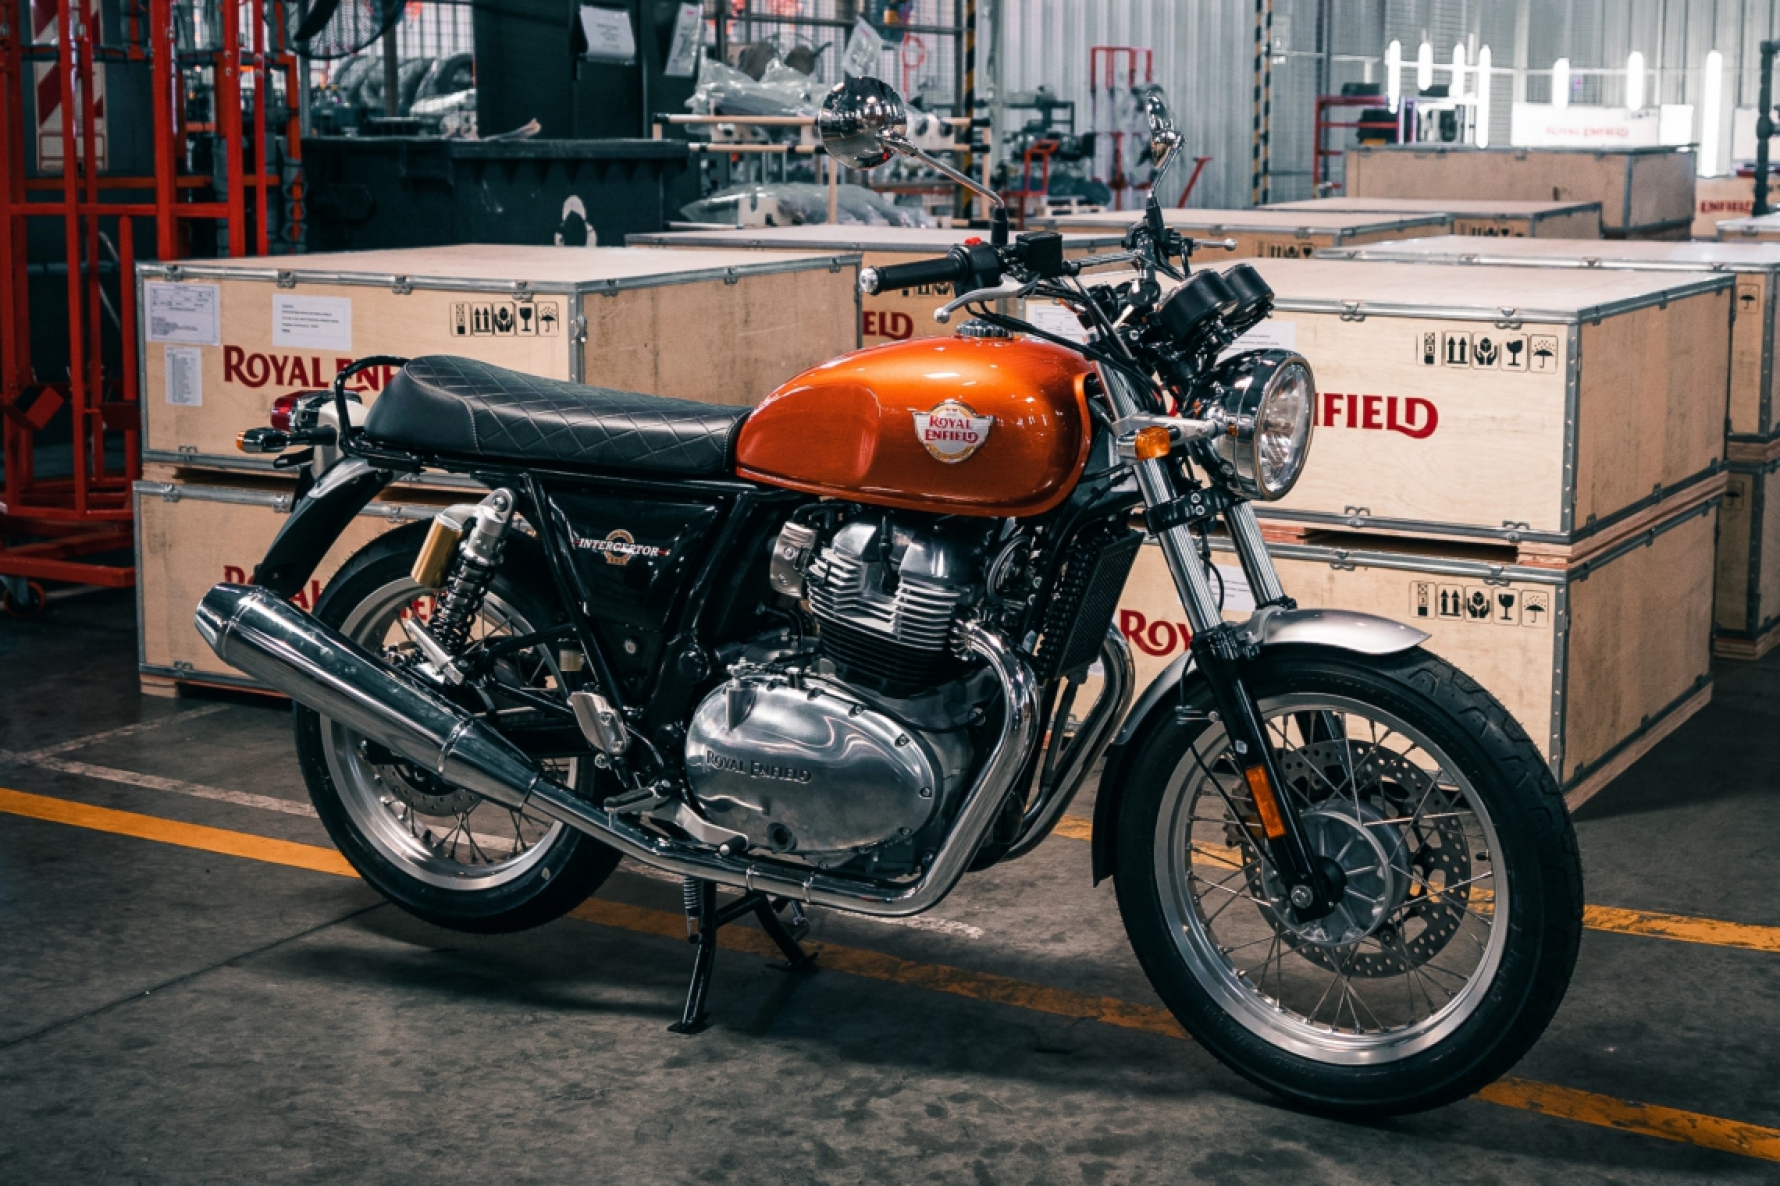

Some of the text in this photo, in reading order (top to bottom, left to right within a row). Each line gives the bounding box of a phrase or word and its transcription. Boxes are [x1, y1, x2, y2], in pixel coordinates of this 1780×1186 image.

[223, 345, 330, 388] ROYAL
[928, 414, 972, 430] ROYAL
[1314, 392, 1438, 439] FIELD
[925, 428, 979, 444] ENFIELD
[579, 537, 661, 557] INTERCEPTOR
[706, 750, 813, 784] ROYAL ENFIELD
